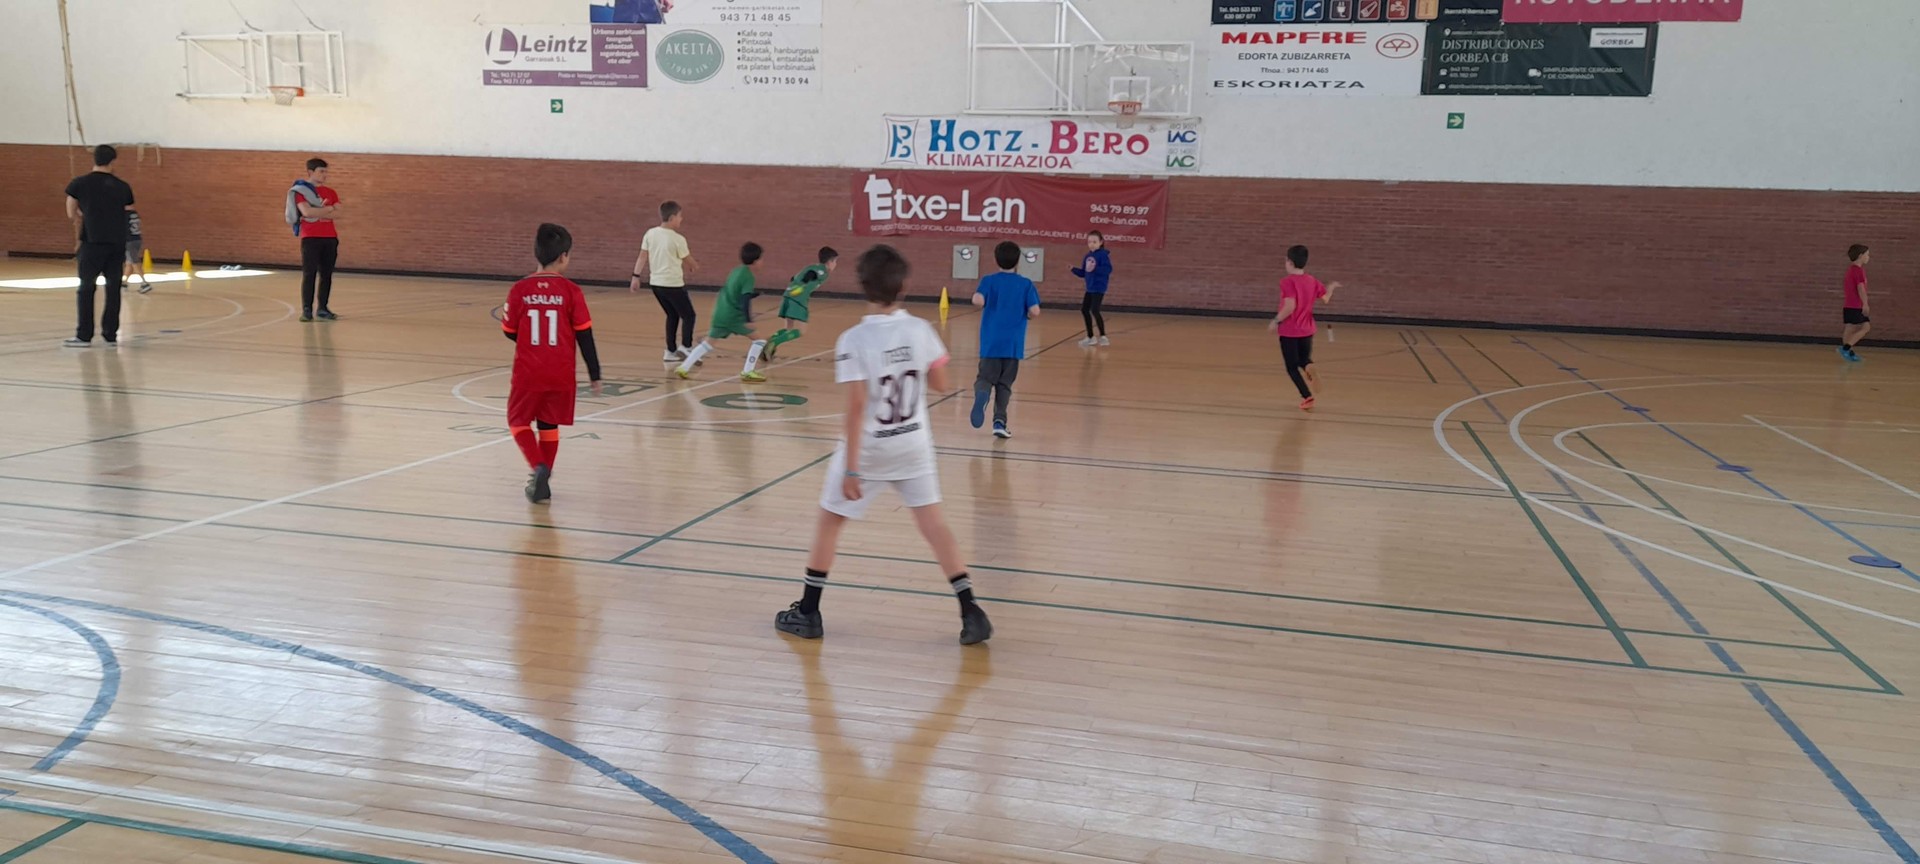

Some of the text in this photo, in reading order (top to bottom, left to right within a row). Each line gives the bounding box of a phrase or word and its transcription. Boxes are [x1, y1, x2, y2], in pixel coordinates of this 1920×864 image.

[720, 13, 791, 21] 943 71 48 45
[520, 35, 587, 52] Leintz
[1221, 32, 1367, 44] MAPFRE
[666, 43, 713, 54] AKEITA
[1442, 39, 1544, 50] DISTRIBUCIONES
[1238, 52, 1351, 61] EDORTA ZUBIZARRETA
[1440, 52, 1509, 63] GORBEA CB
[750, 63, 770, 71] plater
[1213, 80, 1365, 89] ESKORIATZA
[929, 119, 1023, 152] HOTZ
[1049, 120, 1149, 155] BERO
[926, 153, 1072, 169] KLIMATIZAZIOA
[865, 175, 1025, 224] Etxe-Lan
[1090, 204, 1149, 214] 943 79 89 97
[1090, 216, 1148, 226] etxe-lan.com
[527, 309, 558, 345] 11
[876, 370, 919, 424] 30
